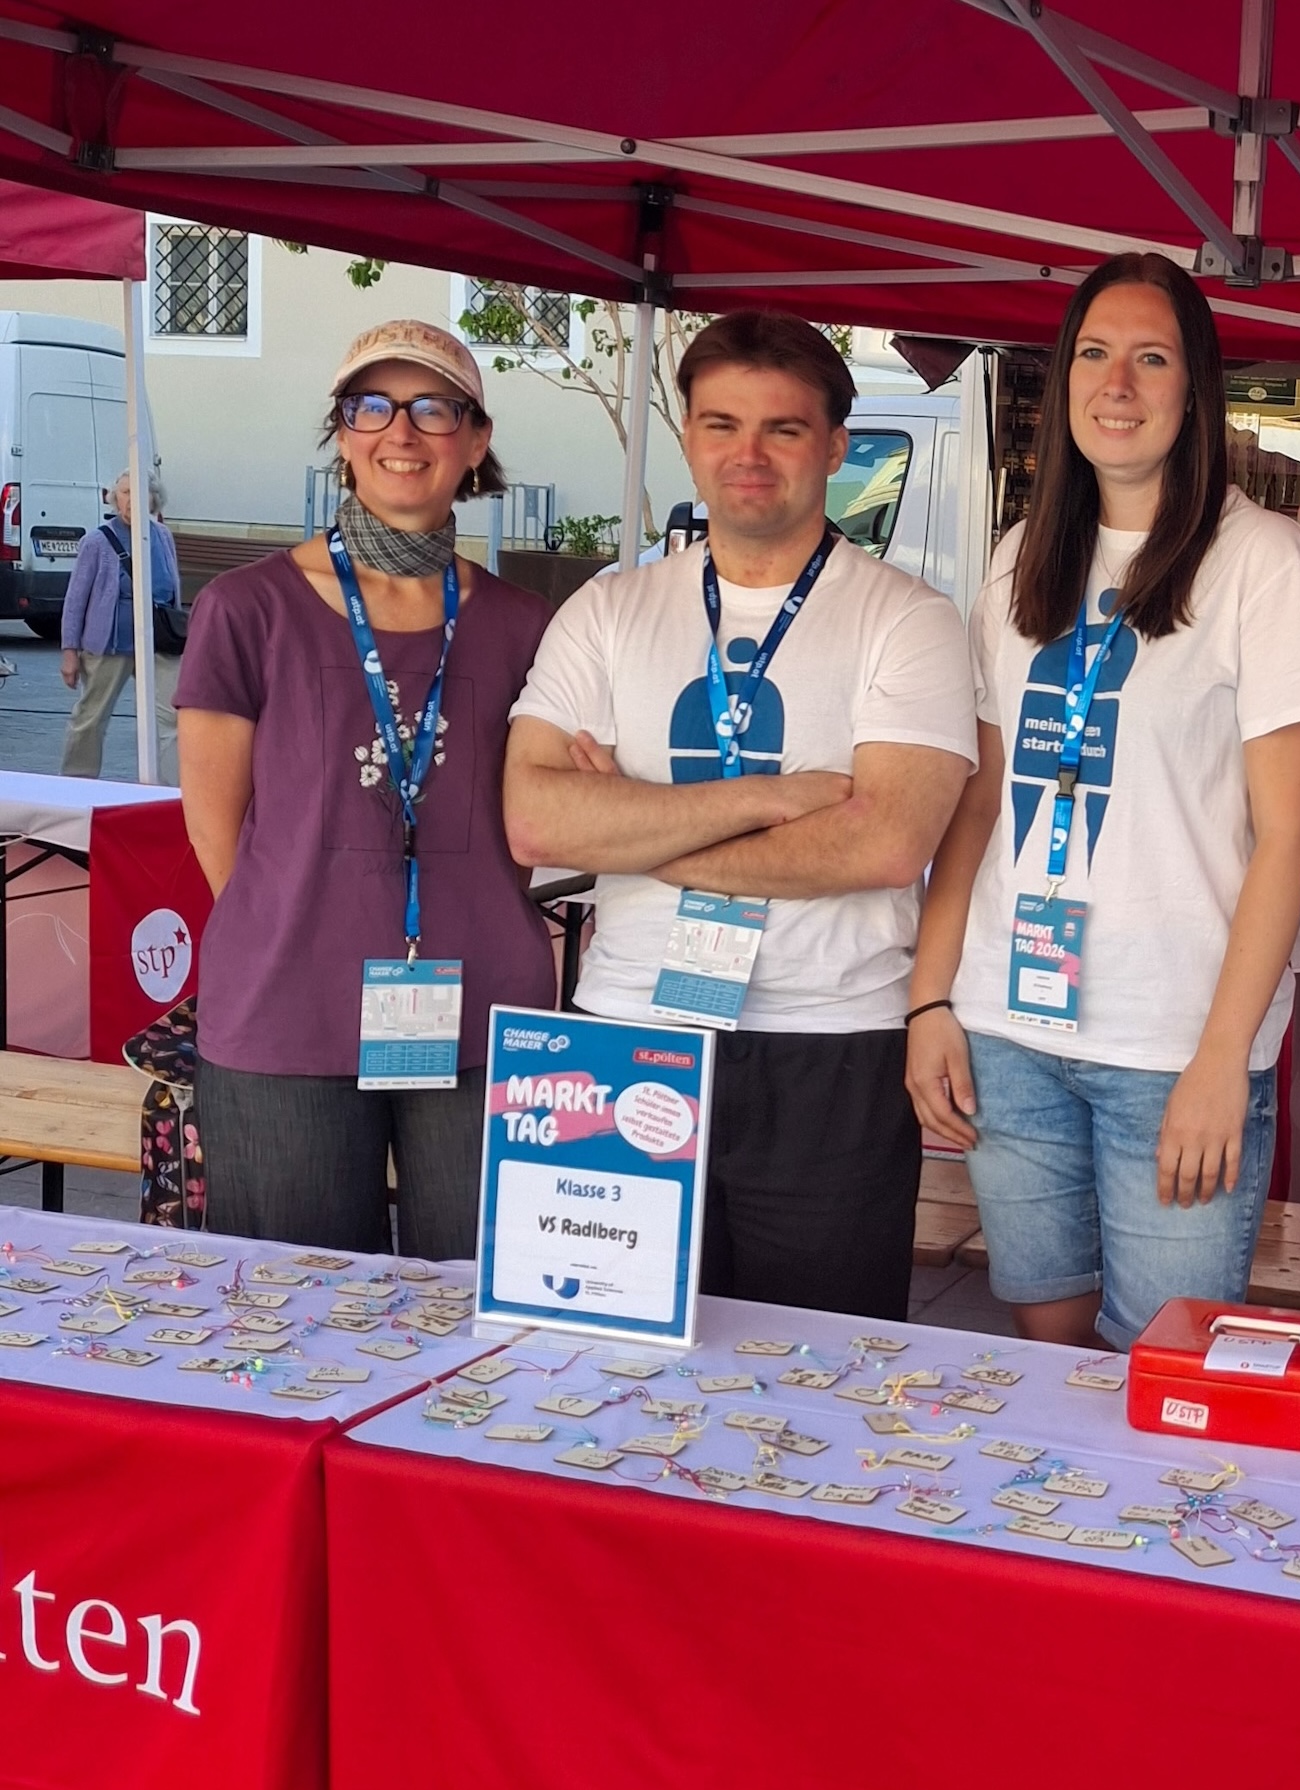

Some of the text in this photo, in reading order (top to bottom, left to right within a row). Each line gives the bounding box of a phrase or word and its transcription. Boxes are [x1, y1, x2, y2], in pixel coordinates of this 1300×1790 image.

[350, 596, 366, 626] ustp.at
[751, 652, 769, 679] ustp.at
[423, 700, 436, 732] ustp.at
[384, 723, 400, 754] ustp.at
[1016, 921, 1055, 940] MARKT
[136, 944, 176, 979] stp
[1015, 938, 1066, 959] TAG 2026
[502, 1037, 544, 1051] MAKER
[503, 1027, 550, 1043] CHANGE
[638, 1050, 691, 1066] st.pölten
[505, 1073, 613, 1116] MARKT
[501, 1111, 559, 1147] TAG
[556, 1177, 622, 1203] Klasse 3
[538, 1214, 639, 1250] VS Radlberg
[0, 1569, 201, 1716] ten
